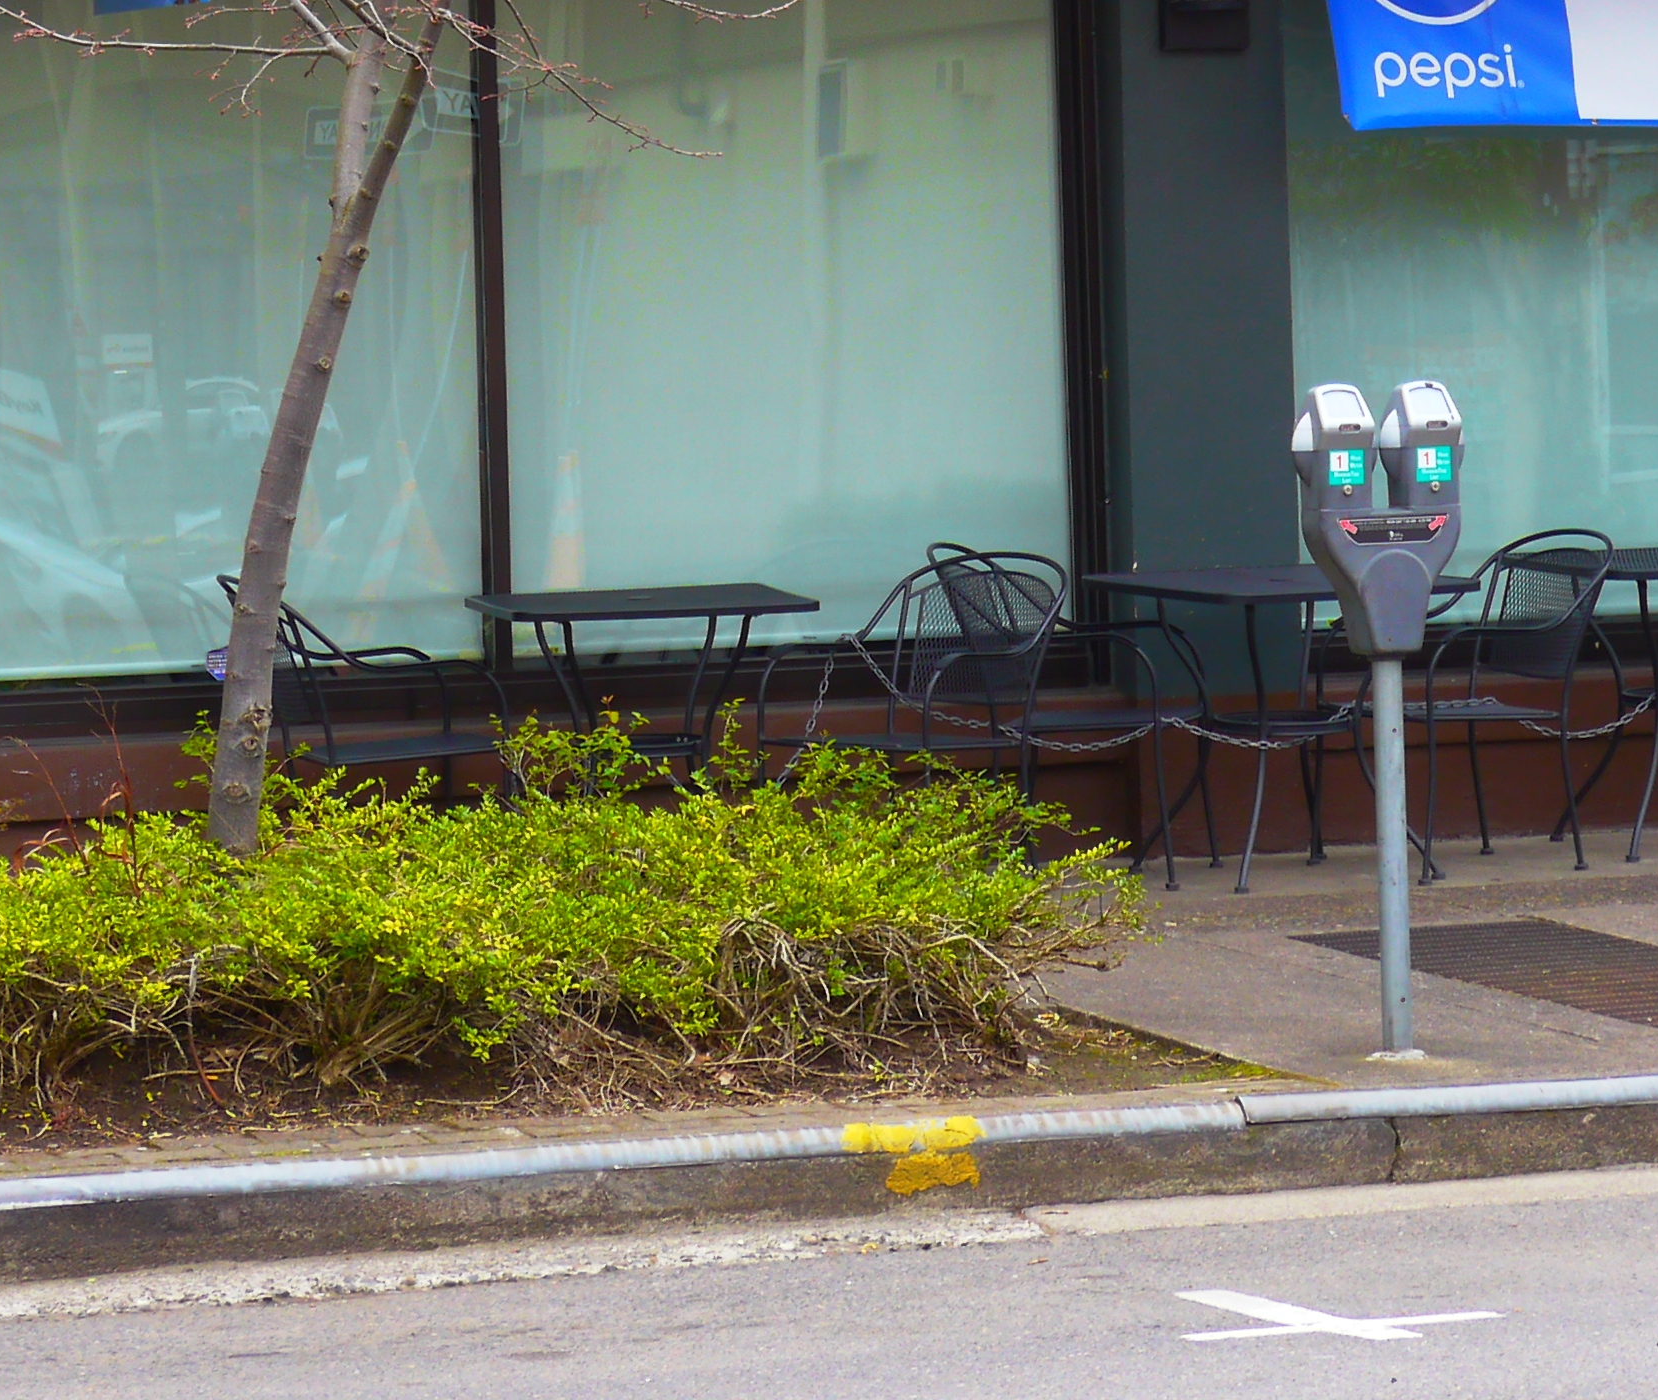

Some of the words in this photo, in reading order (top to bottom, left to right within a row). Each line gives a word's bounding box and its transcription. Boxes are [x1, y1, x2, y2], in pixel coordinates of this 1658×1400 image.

[1374, 44, 1517, 98] pepsi
[1336, 455, 1342, 468] 1
[1423, 452, 1429, 466] 1
